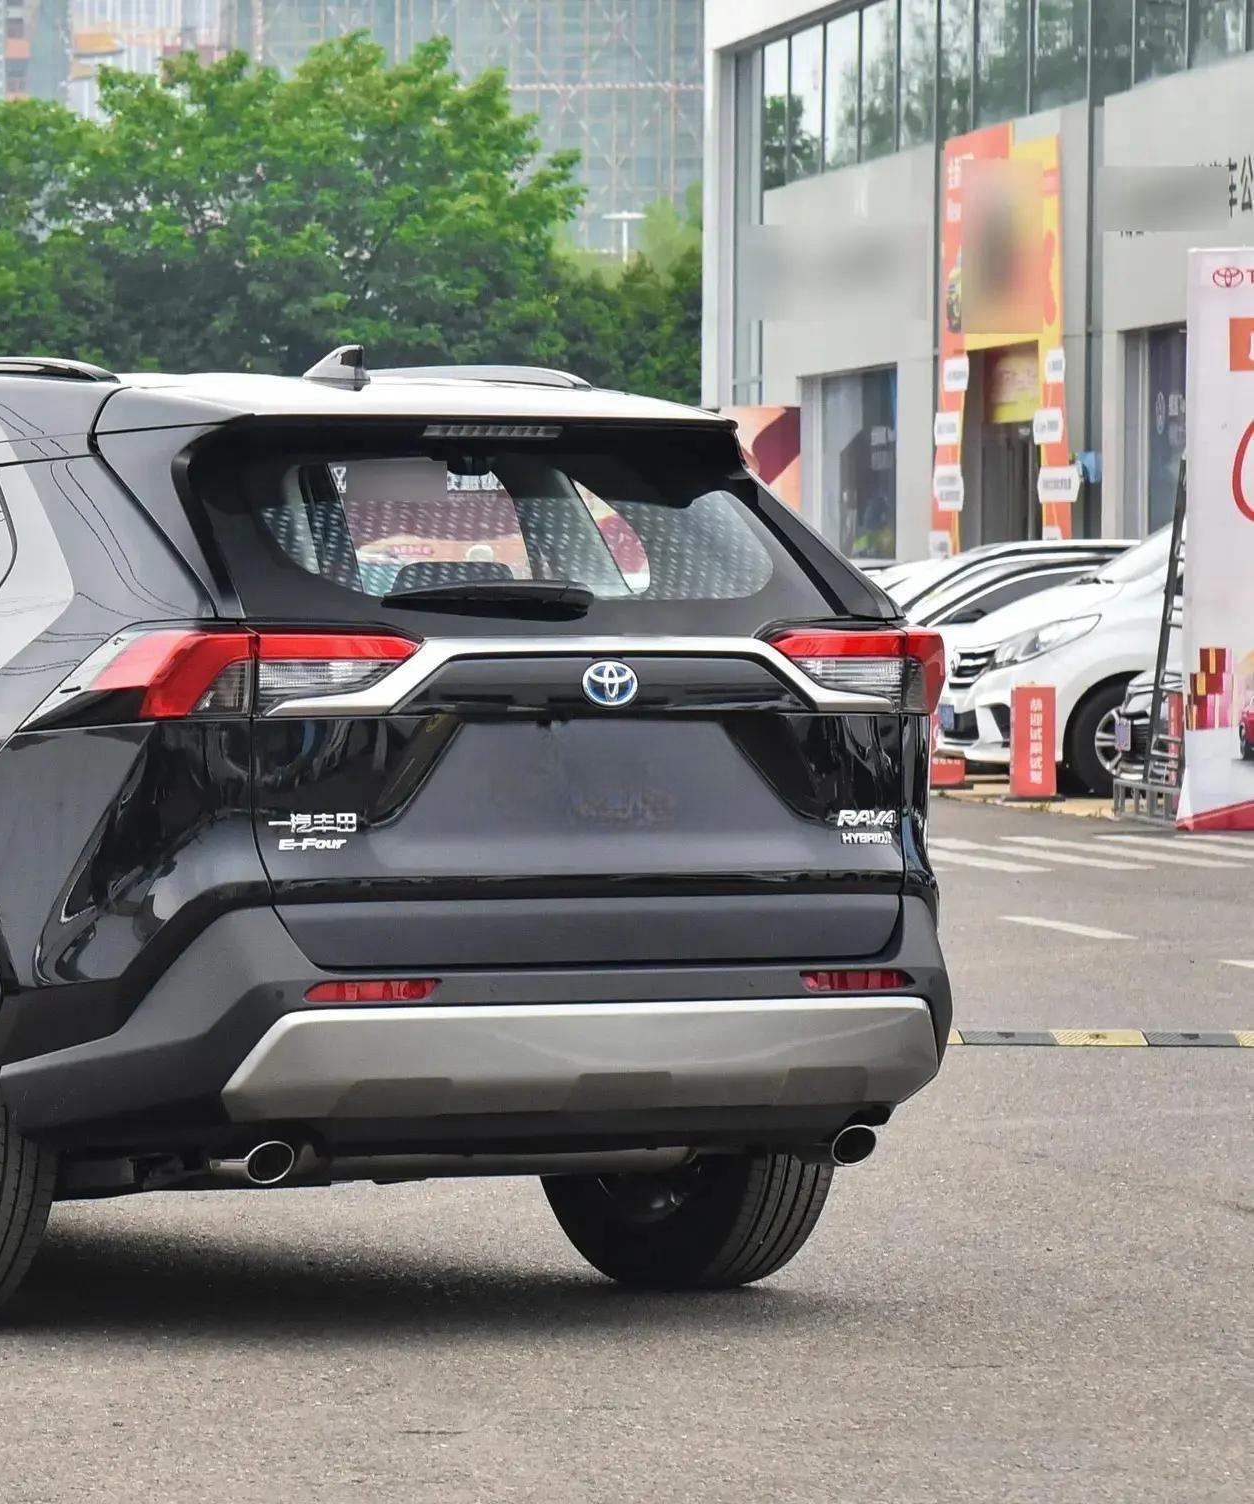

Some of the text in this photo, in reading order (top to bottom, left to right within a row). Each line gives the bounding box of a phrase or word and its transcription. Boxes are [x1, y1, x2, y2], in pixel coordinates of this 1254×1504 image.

[268, 813, 357, 833] 一汽丰田
[837, 809, 897, 828] RAV4
[278, 838, 347, 851] E-Four
[841, 832, 885, 844] HYBRID
